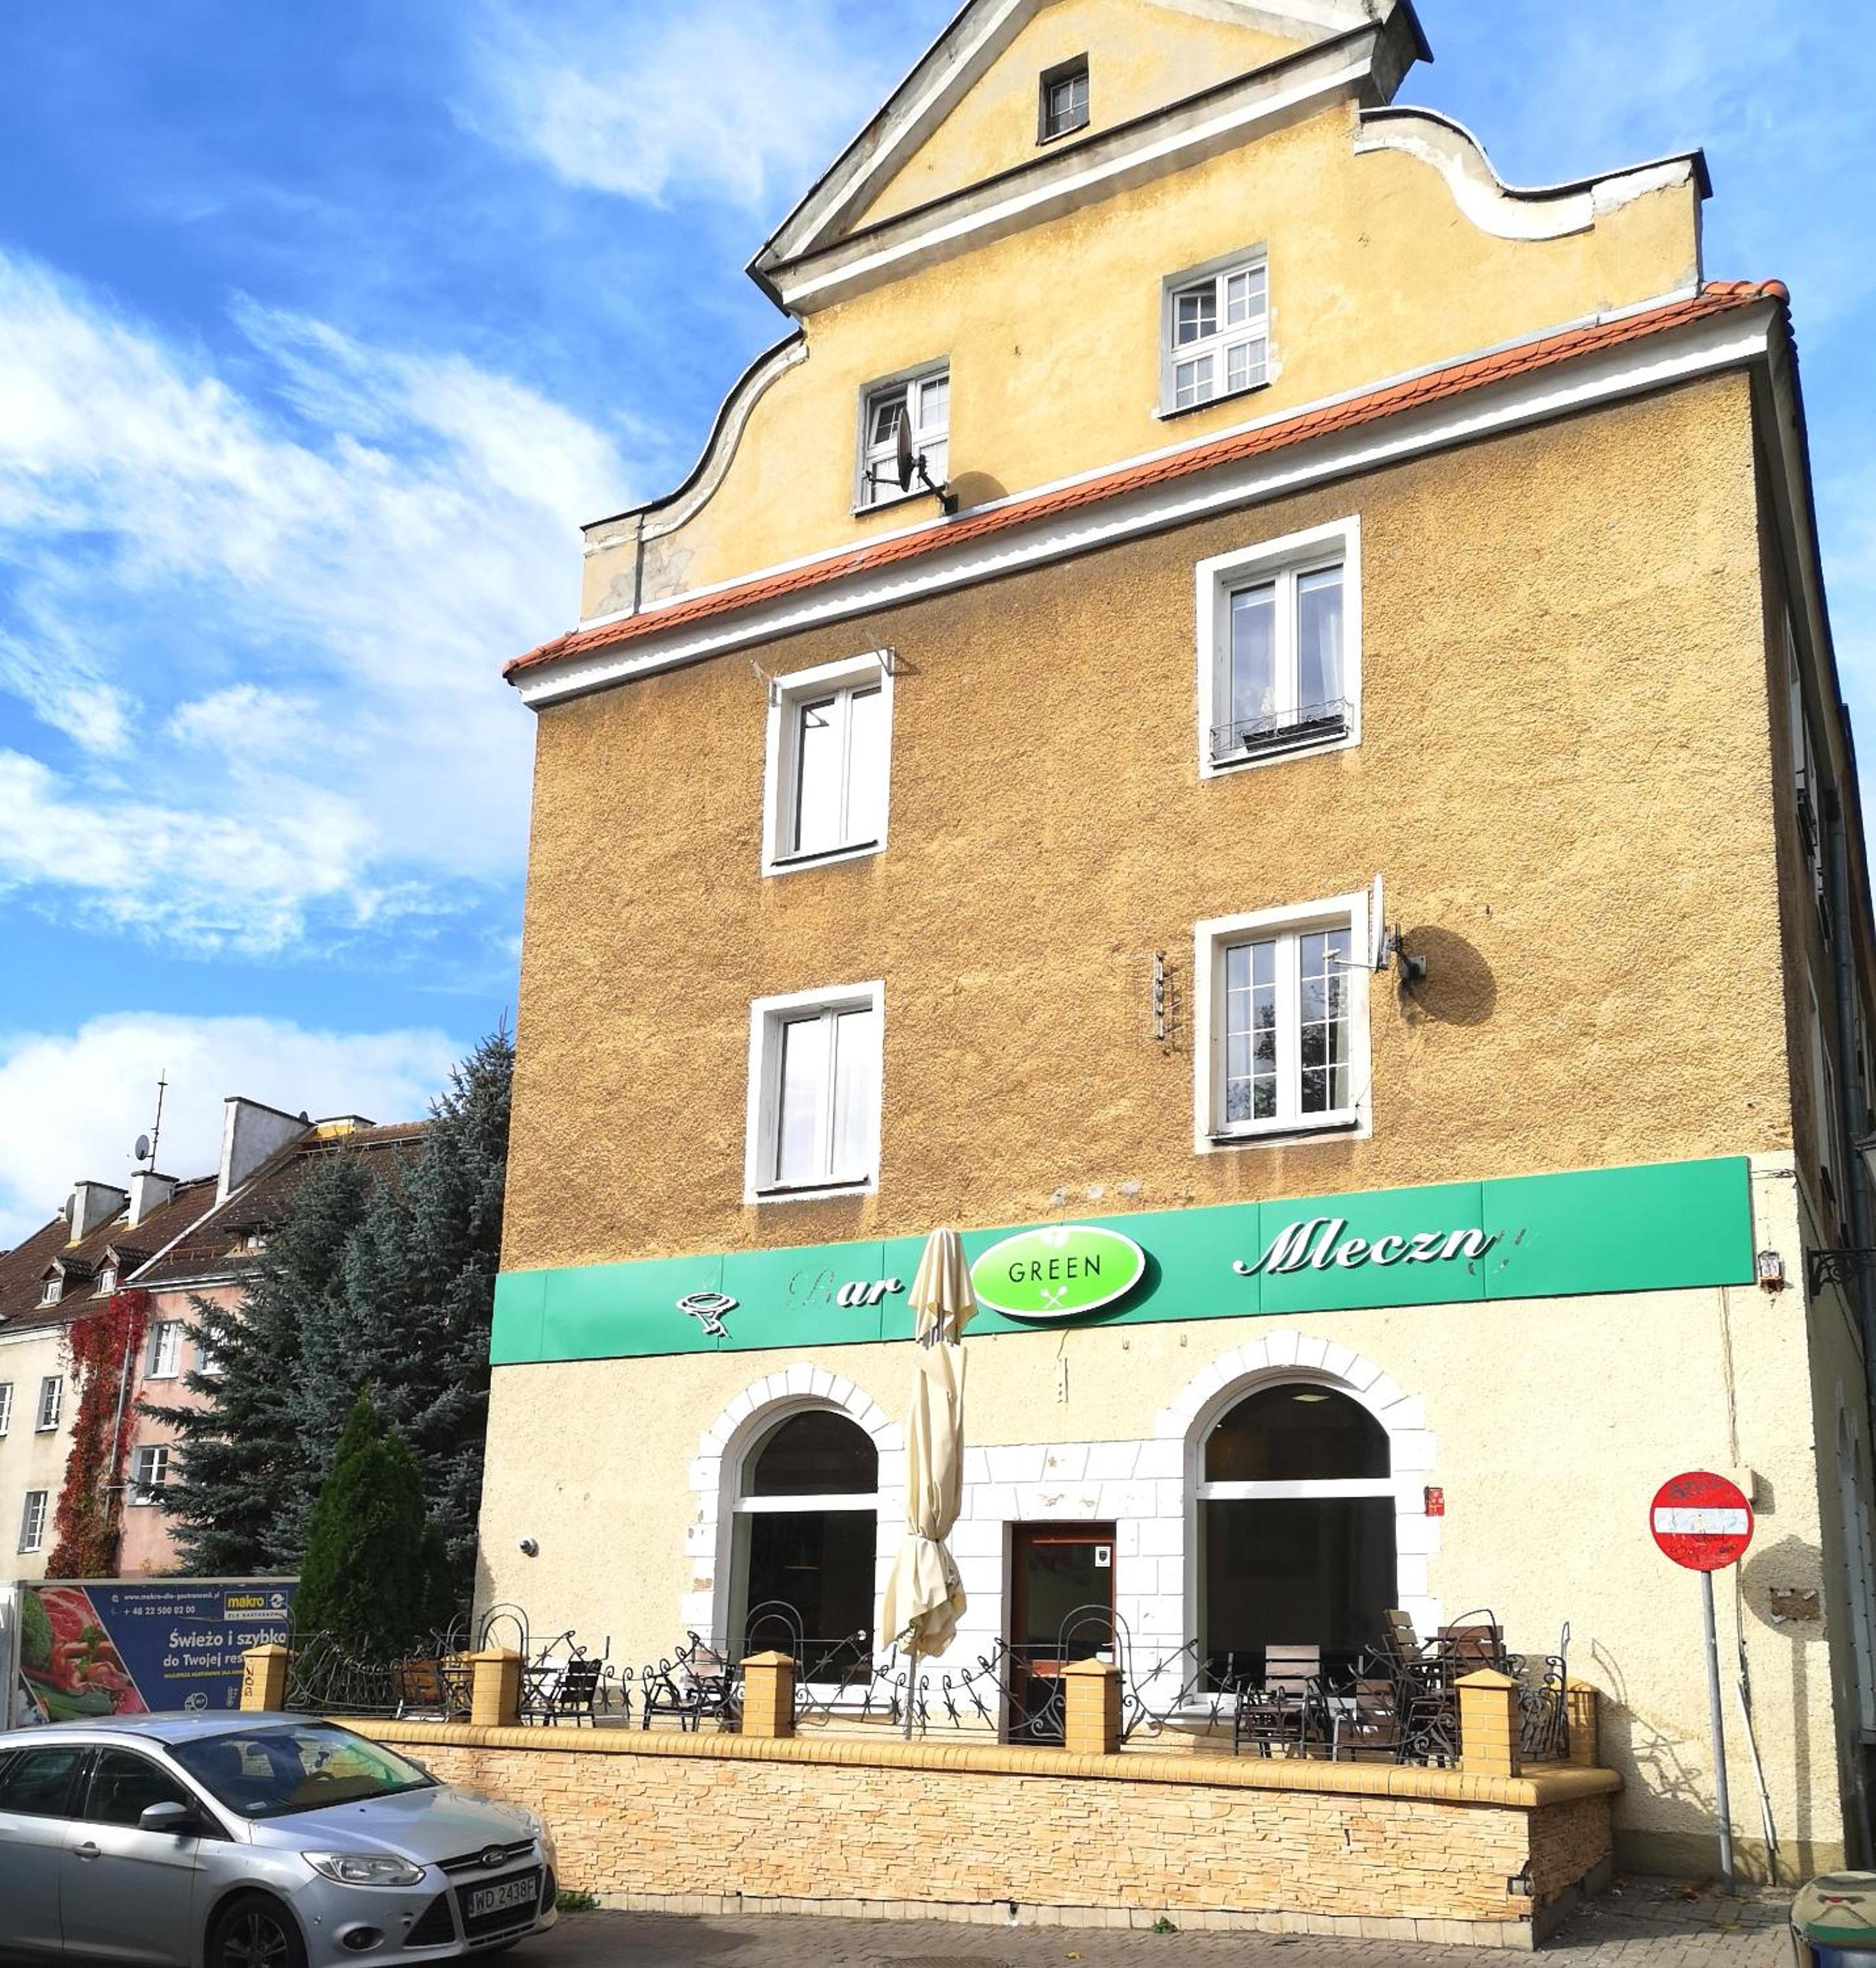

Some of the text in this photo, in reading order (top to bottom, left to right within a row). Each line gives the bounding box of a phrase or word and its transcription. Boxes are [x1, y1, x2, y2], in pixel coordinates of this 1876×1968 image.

[1233, 1217, 1528, 1277] Mleczn
[1008, 1254, 1101, 1283] GREEN
[157, 1607, 172, 1615] 500
[228, 1596, 264, 1608] makro
[169, 1628, 224, 1648] Świeżo
[228, 1631, 233, 1646] i
[163, 1653, 243, 1668] do Twojej res
[477, 1880, 535, 1910] WD 2438F
